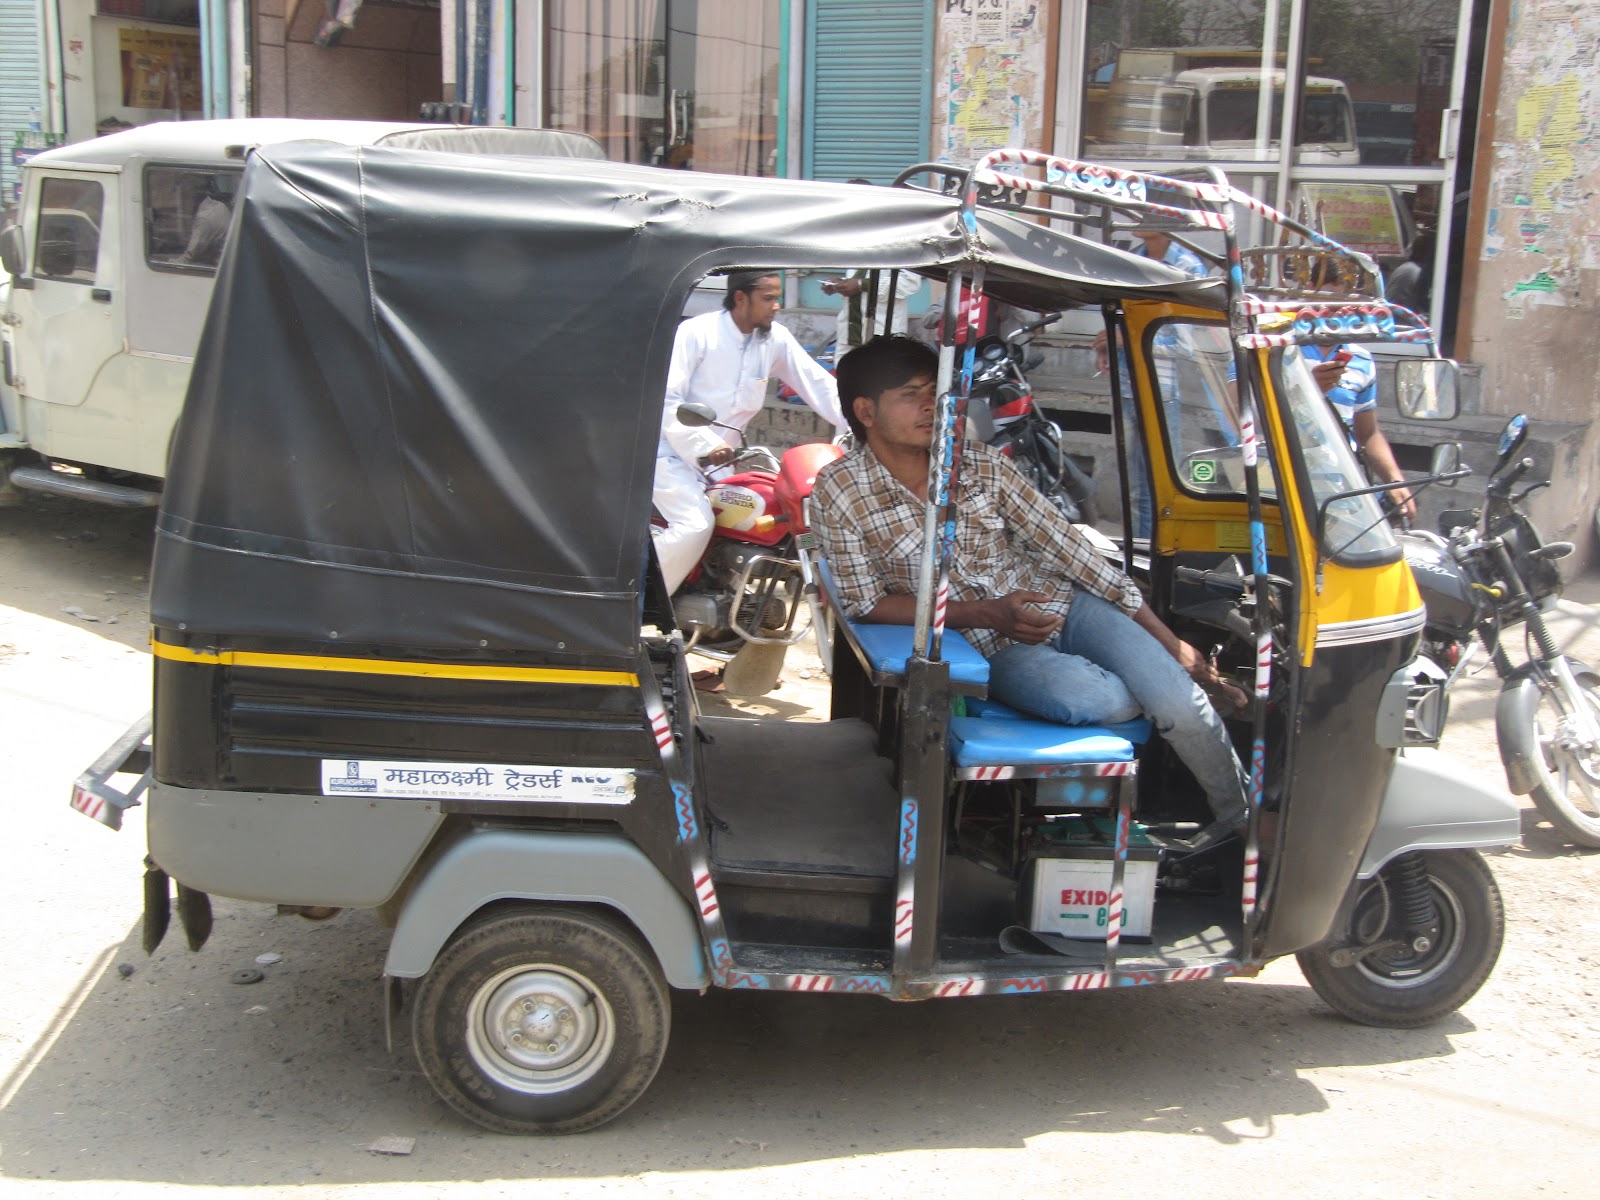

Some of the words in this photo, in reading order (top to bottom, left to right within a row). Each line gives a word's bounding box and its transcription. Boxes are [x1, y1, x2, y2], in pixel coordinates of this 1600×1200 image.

[977, 12, 1002, 20] HOUSE
[721, 496, 754, 508] HONDA
[384, 767, 494, 787] महालक्ष्मी
[504, 769, 563, 790] ट्रेडर्स
[1061, 889, 1109, 905] EXID
